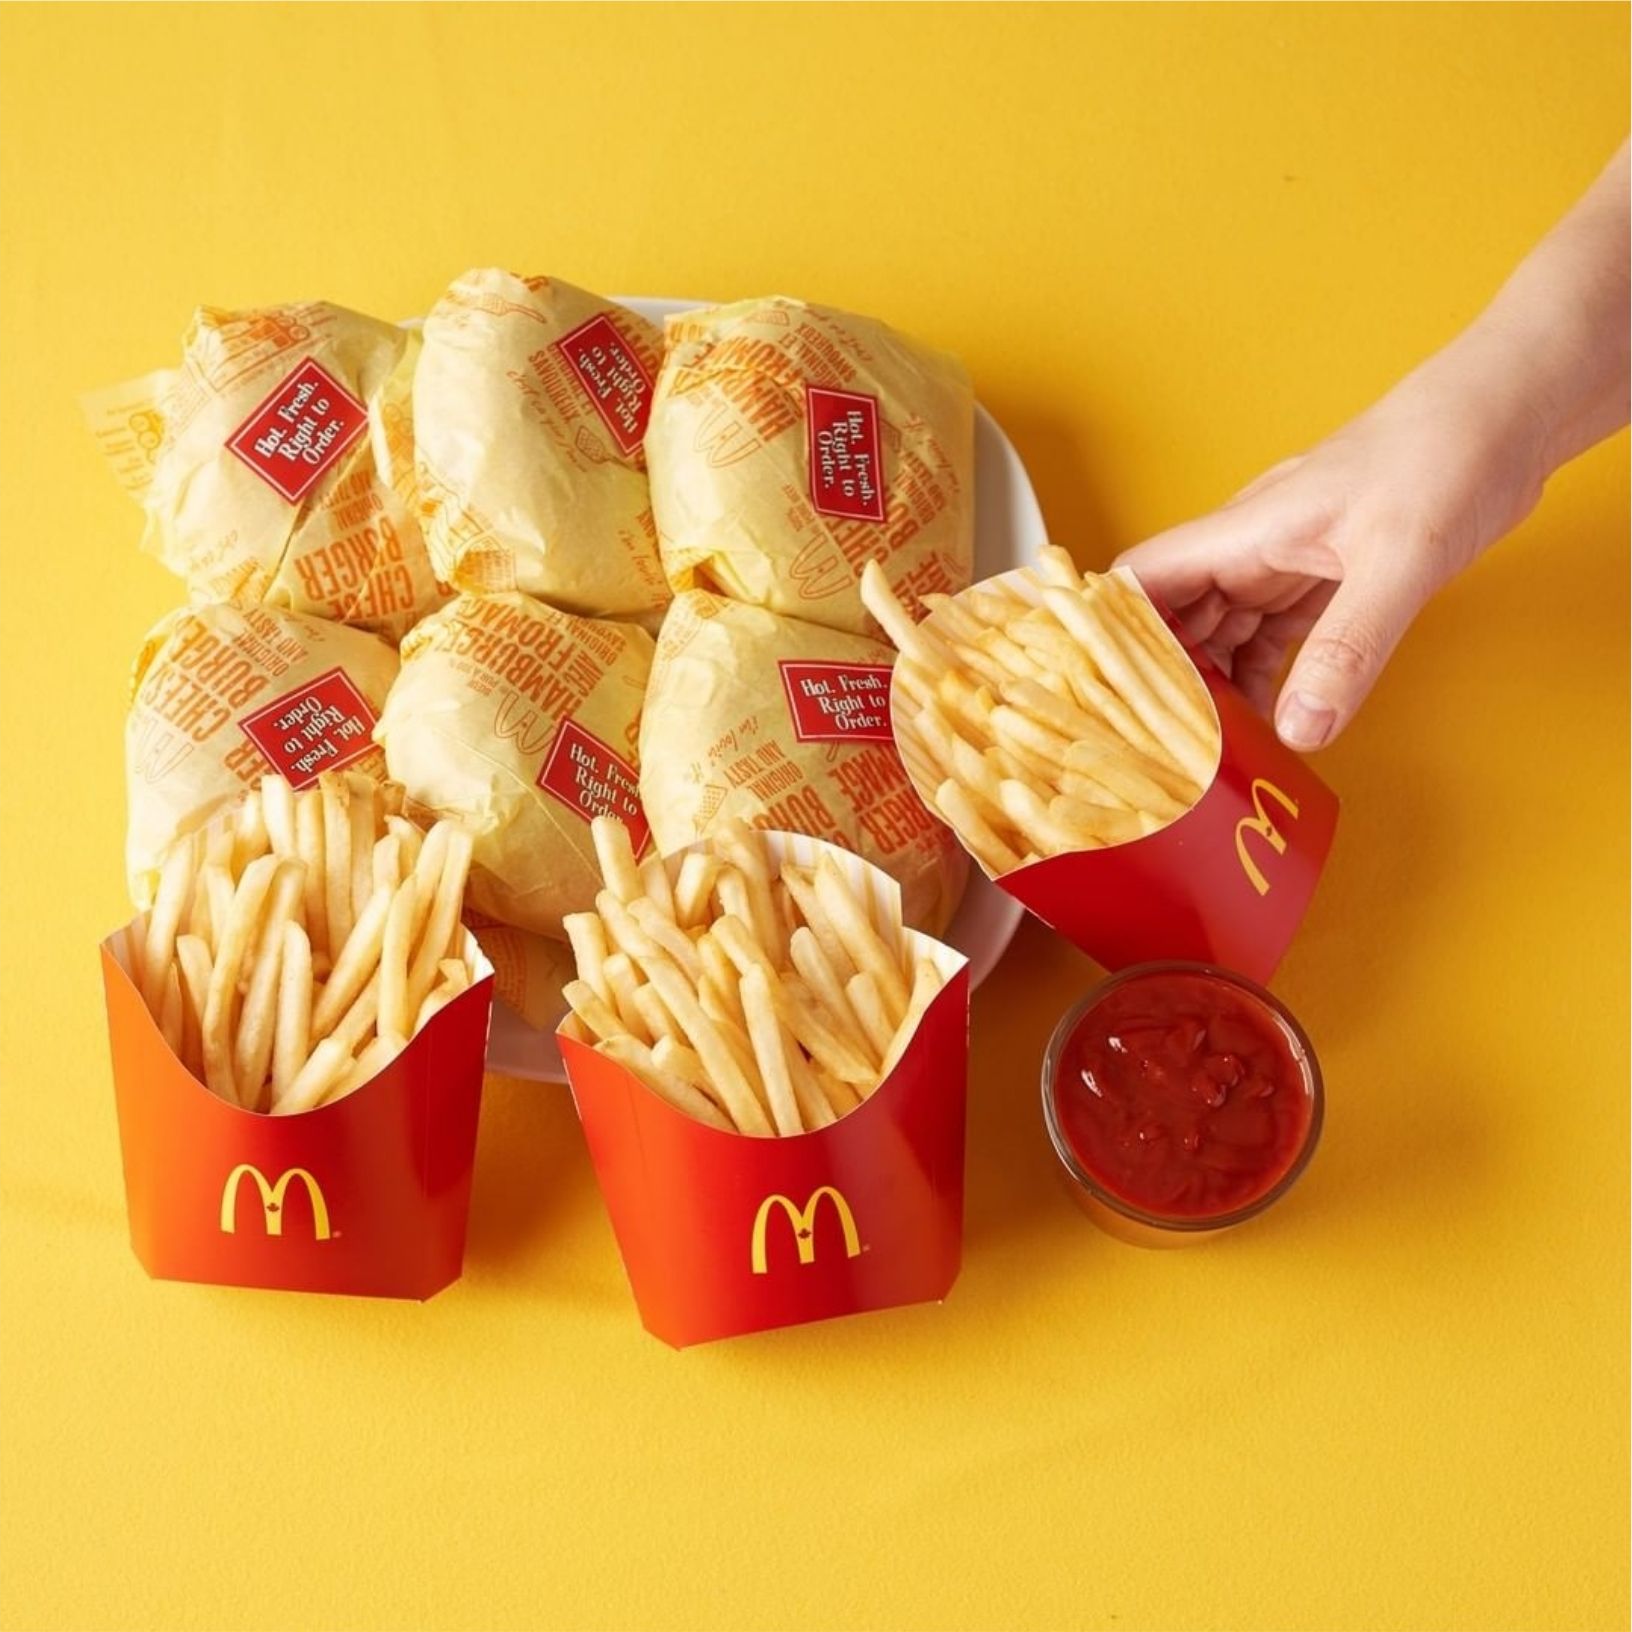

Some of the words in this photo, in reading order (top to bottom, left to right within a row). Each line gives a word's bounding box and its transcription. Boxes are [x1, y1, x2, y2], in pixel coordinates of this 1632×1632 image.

[578, 348, 613, 399] Fresh.
[591, 346, 607, 365] to
[608, 342, 647, 395] Order.
[606, 367, 643, 414] Right
[253, 427, 288, 458] Hot.
[277, 382, 319, 423] Fresh.
[277, 416, 319, 461] Right
[311, 398, 330, 415] to
[615, 398, 639, 434] Hot.
[847, 411, 865, 445] Hot.
[302, 420, 344, 464] Order.
[818, 430, 836, 489] Order.
[832, 422, 852, 471] Right
[841, 479, 855, 497] to
[854, 454, 875, 507] Fresh.
[800, 678, 836, 697] Hot.
[838, 674, 888, 692] Fresh.
[272, 696, 323, 731] Order.
[818, 694, 866, 716] Right
[868, 694, 887, 709] to
[835, 711, 888, 730] Order.
[300, 705, 347, 742] Right
[332, 715, 366, 741] Hot.
[283, 737, 305, 754] to
[291, 738, 339, 773] Fresh.
[569, 743, 599, 774] Hot.
[575, 765, 617, 804] Right
[623, 796, 638, 816] to
